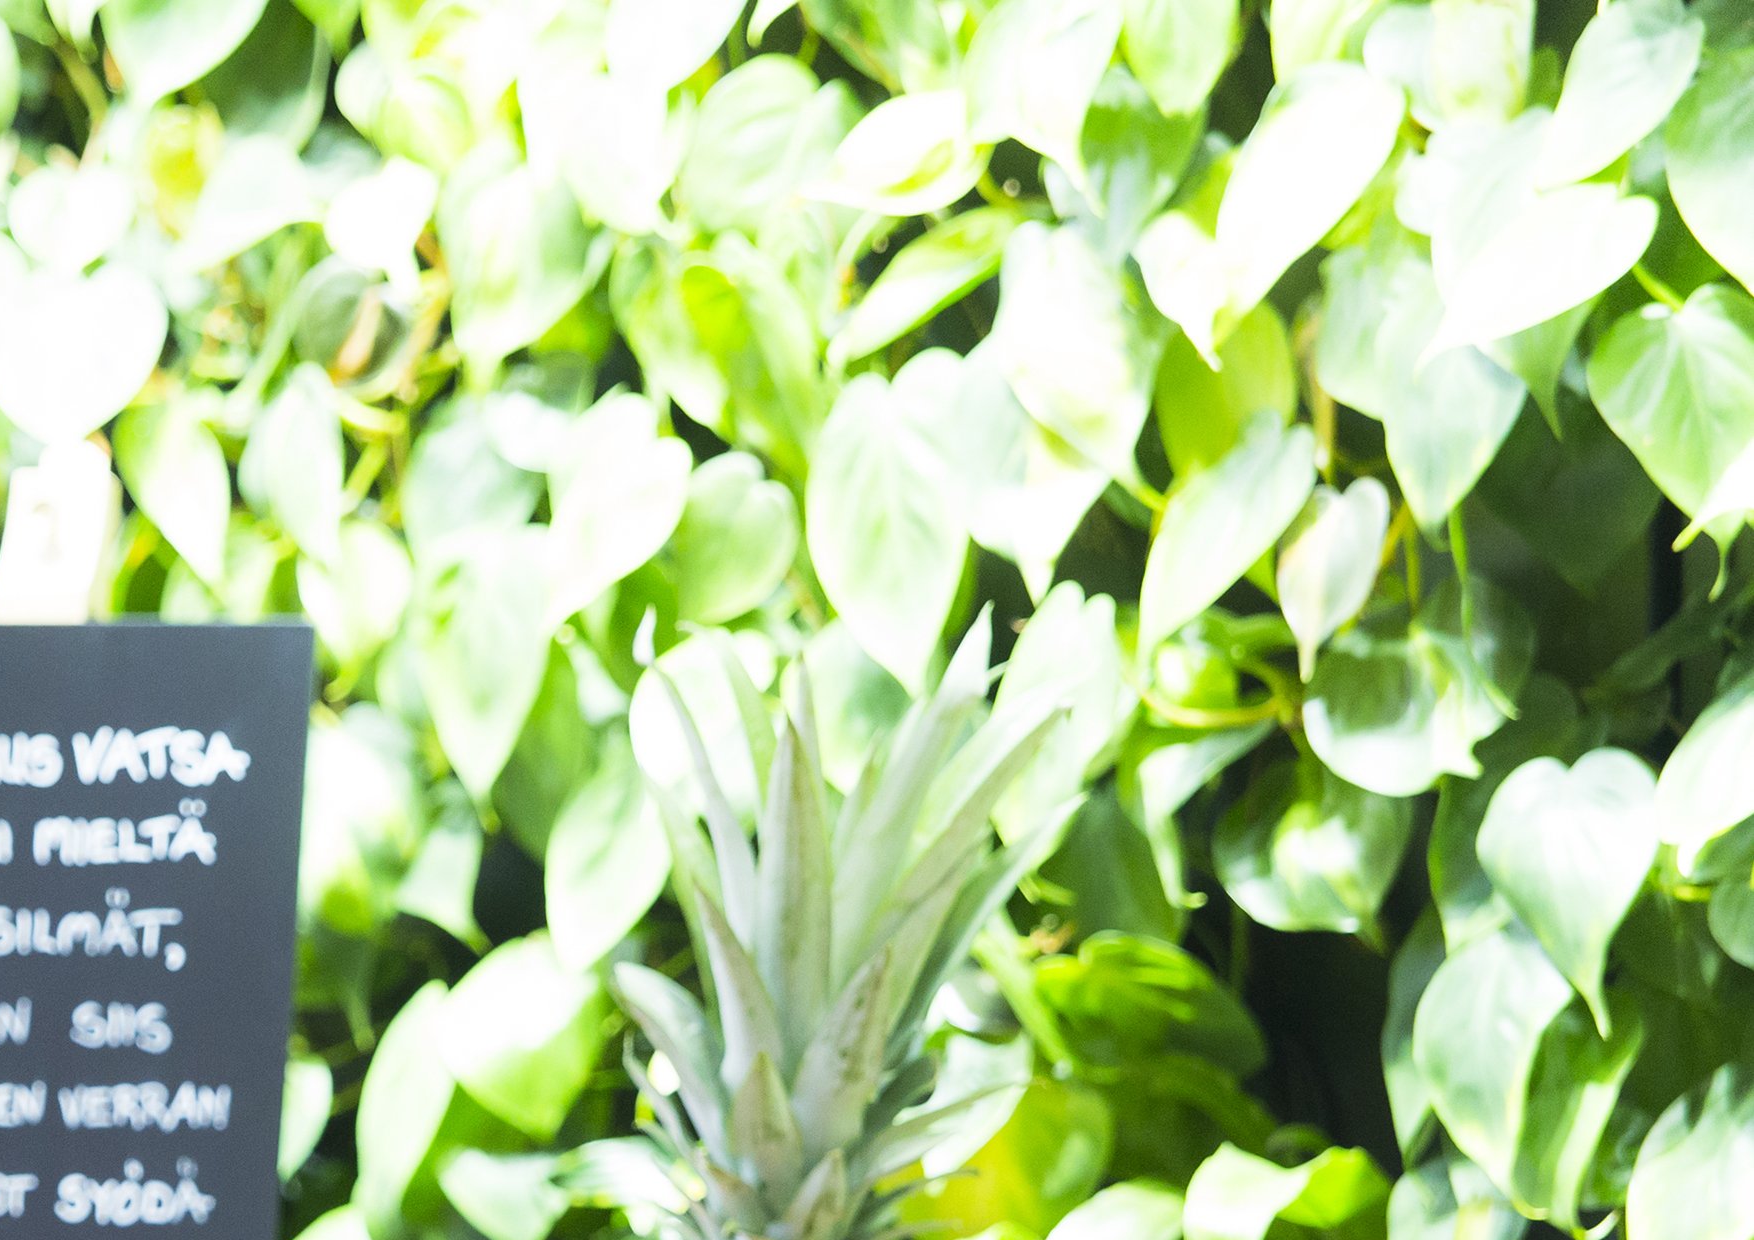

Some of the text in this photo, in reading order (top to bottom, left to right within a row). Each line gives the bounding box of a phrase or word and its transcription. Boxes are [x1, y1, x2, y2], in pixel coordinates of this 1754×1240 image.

[71, 724, 252, 788] VATSA
[32, 797, 217, 867] MIELTÄ
[70, 1000, 173, 1054] SIIS
[58, 1081, 232, 1133] VERRAN
